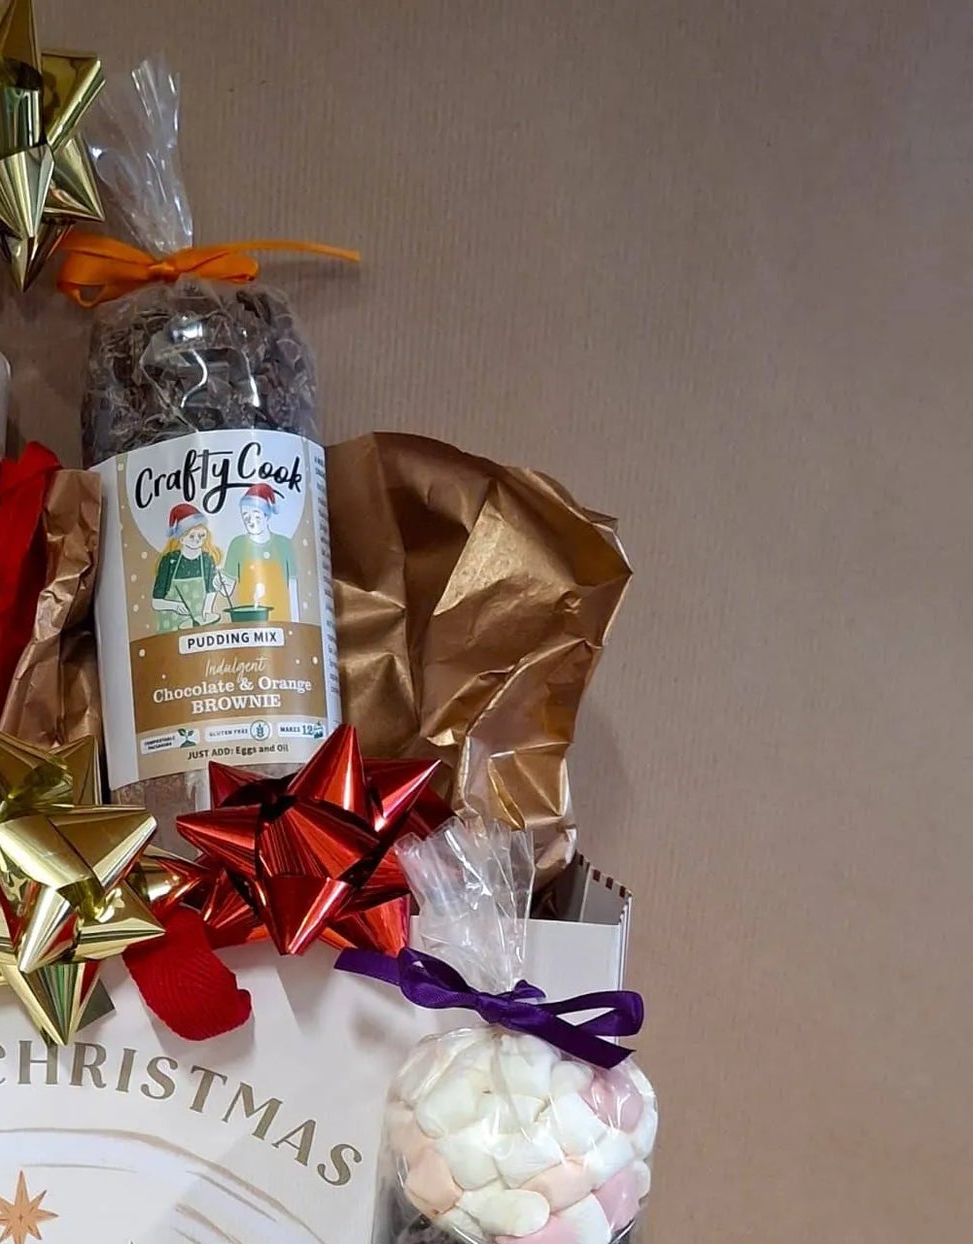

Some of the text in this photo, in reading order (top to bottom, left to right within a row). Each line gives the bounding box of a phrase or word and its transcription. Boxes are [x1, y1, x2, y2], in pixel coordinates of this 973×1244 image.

[135, 441, 303, 513] Crafty Cook
[187, 630, 277, 650] PUDDING MIX
[205, 655, 268, 681] Indulgent
[153, 676, 312, 704] Chocolate & Orange
[191, 693, 281, 715] BROWNIE
[209, 728, 232, 737] GLUTEN
[302, 724, 313, 736] 12
[187, 743, 289, 760] JUST ADD: Eggs and Oil
